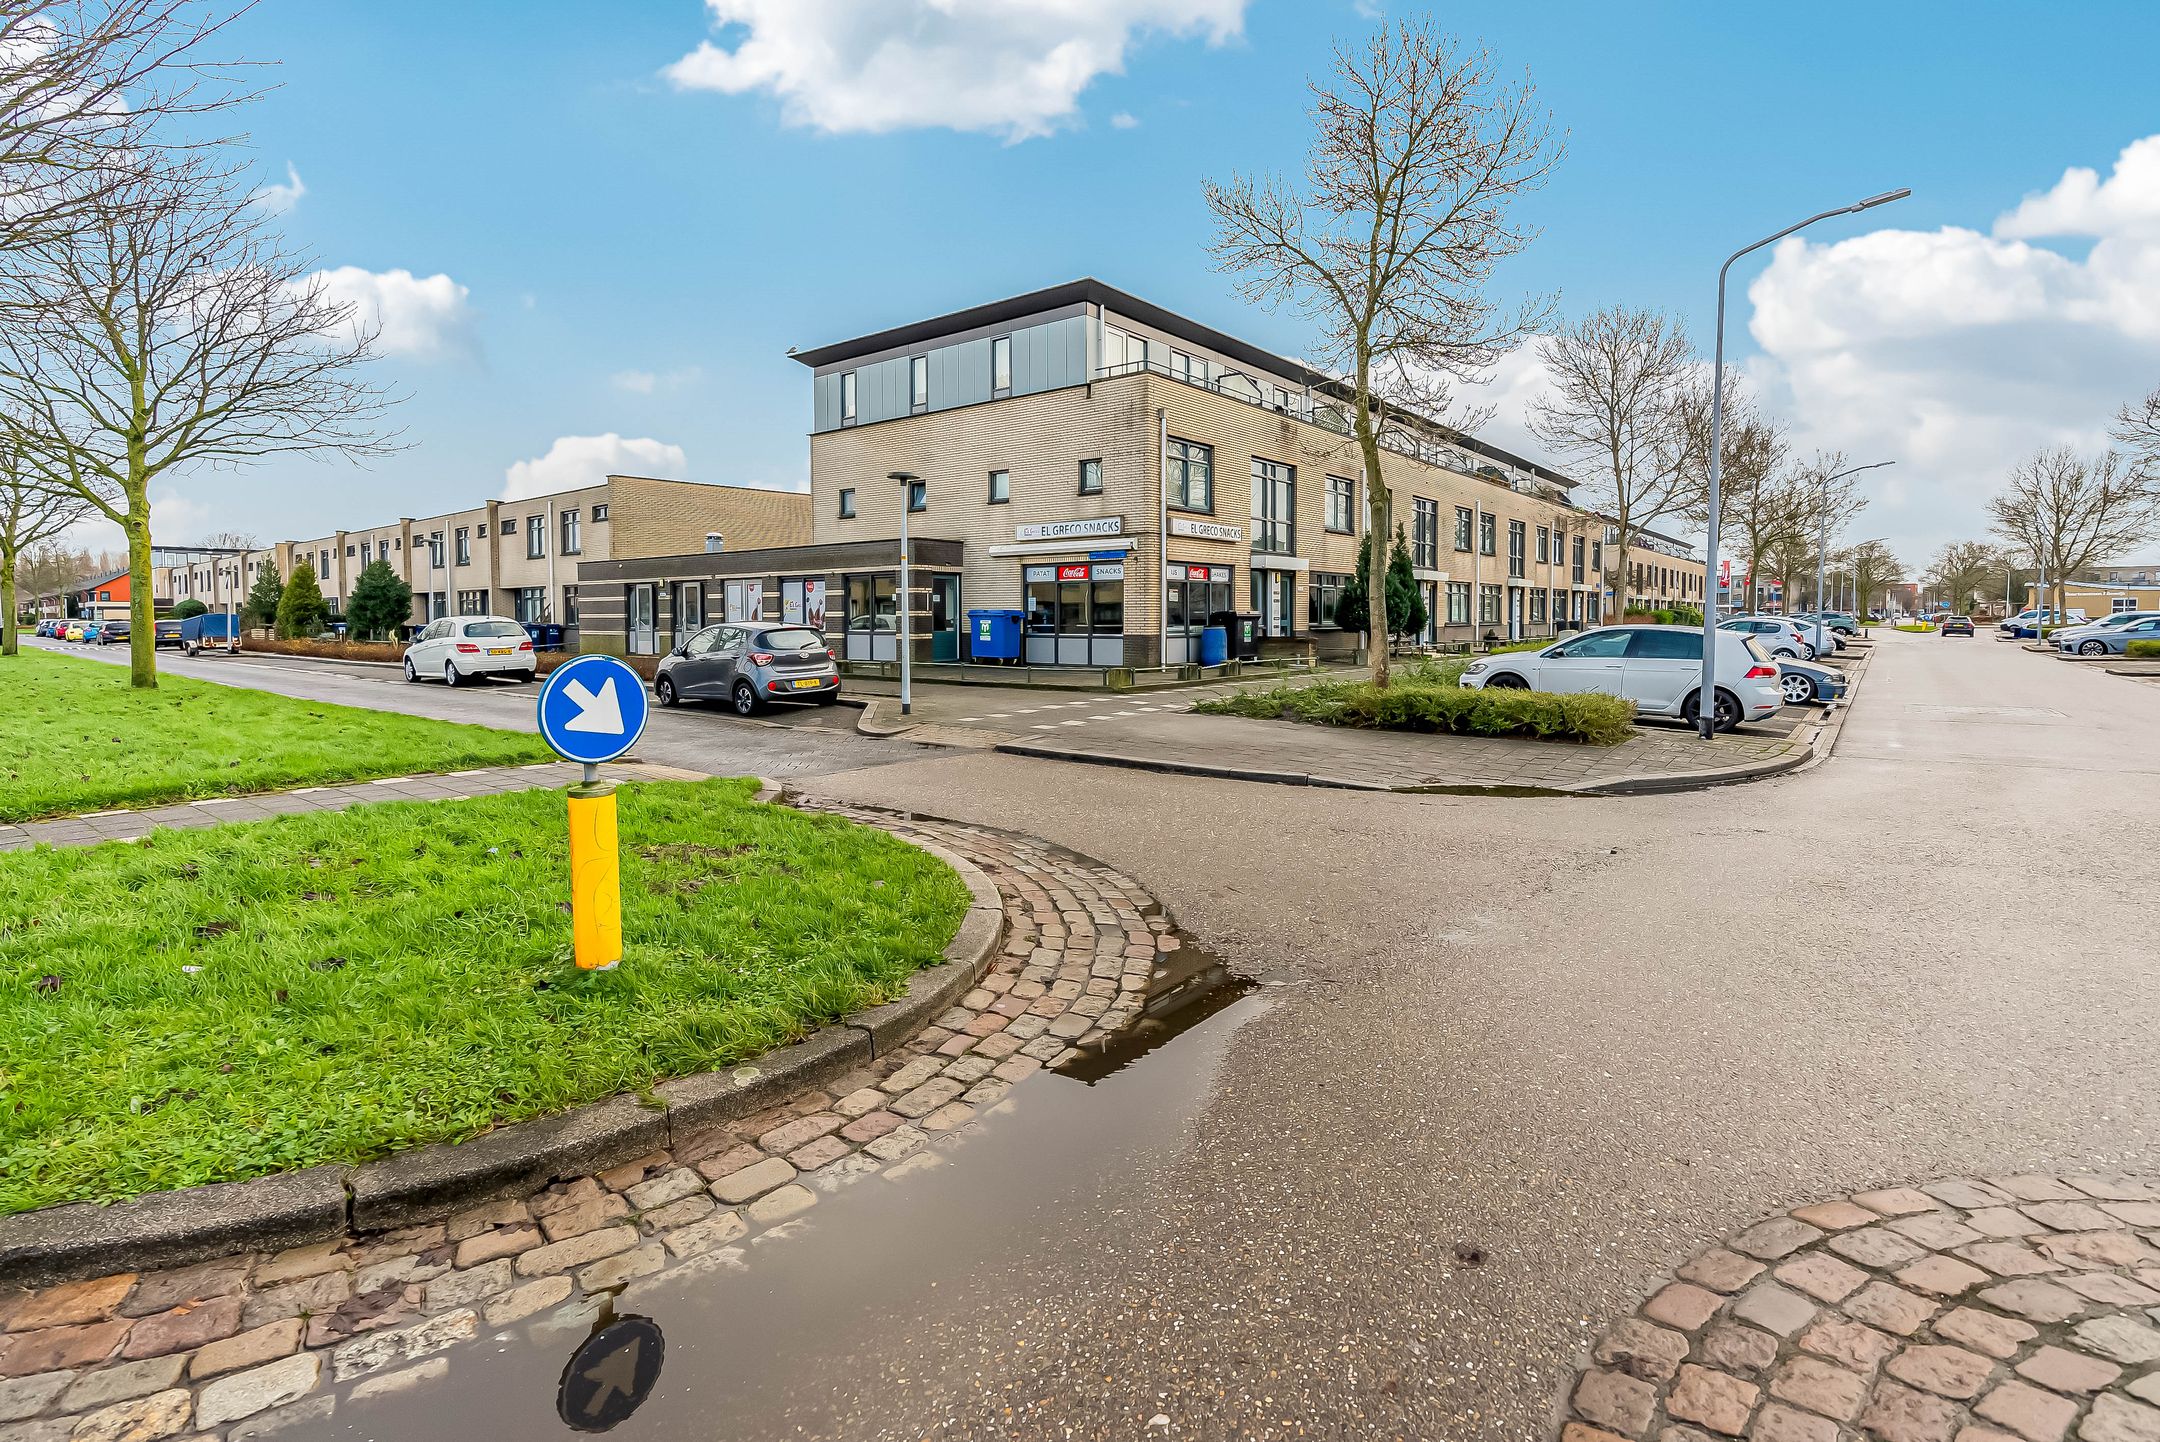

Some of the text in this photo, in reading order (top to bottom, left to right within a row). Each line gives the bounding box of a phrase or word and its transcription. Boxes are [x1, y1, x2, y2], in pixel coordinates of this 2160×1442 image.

[1041, 526, 1051, 536] EL
[1052, 524, 1081, 535] GRECO
[1084, 521, 1119, 533] SNACKS
[1191, 524, 1197, 534] EL
[1199, 525, 1218, 536] GRECO
[1220, 527, 1240, 538] SNACKS
